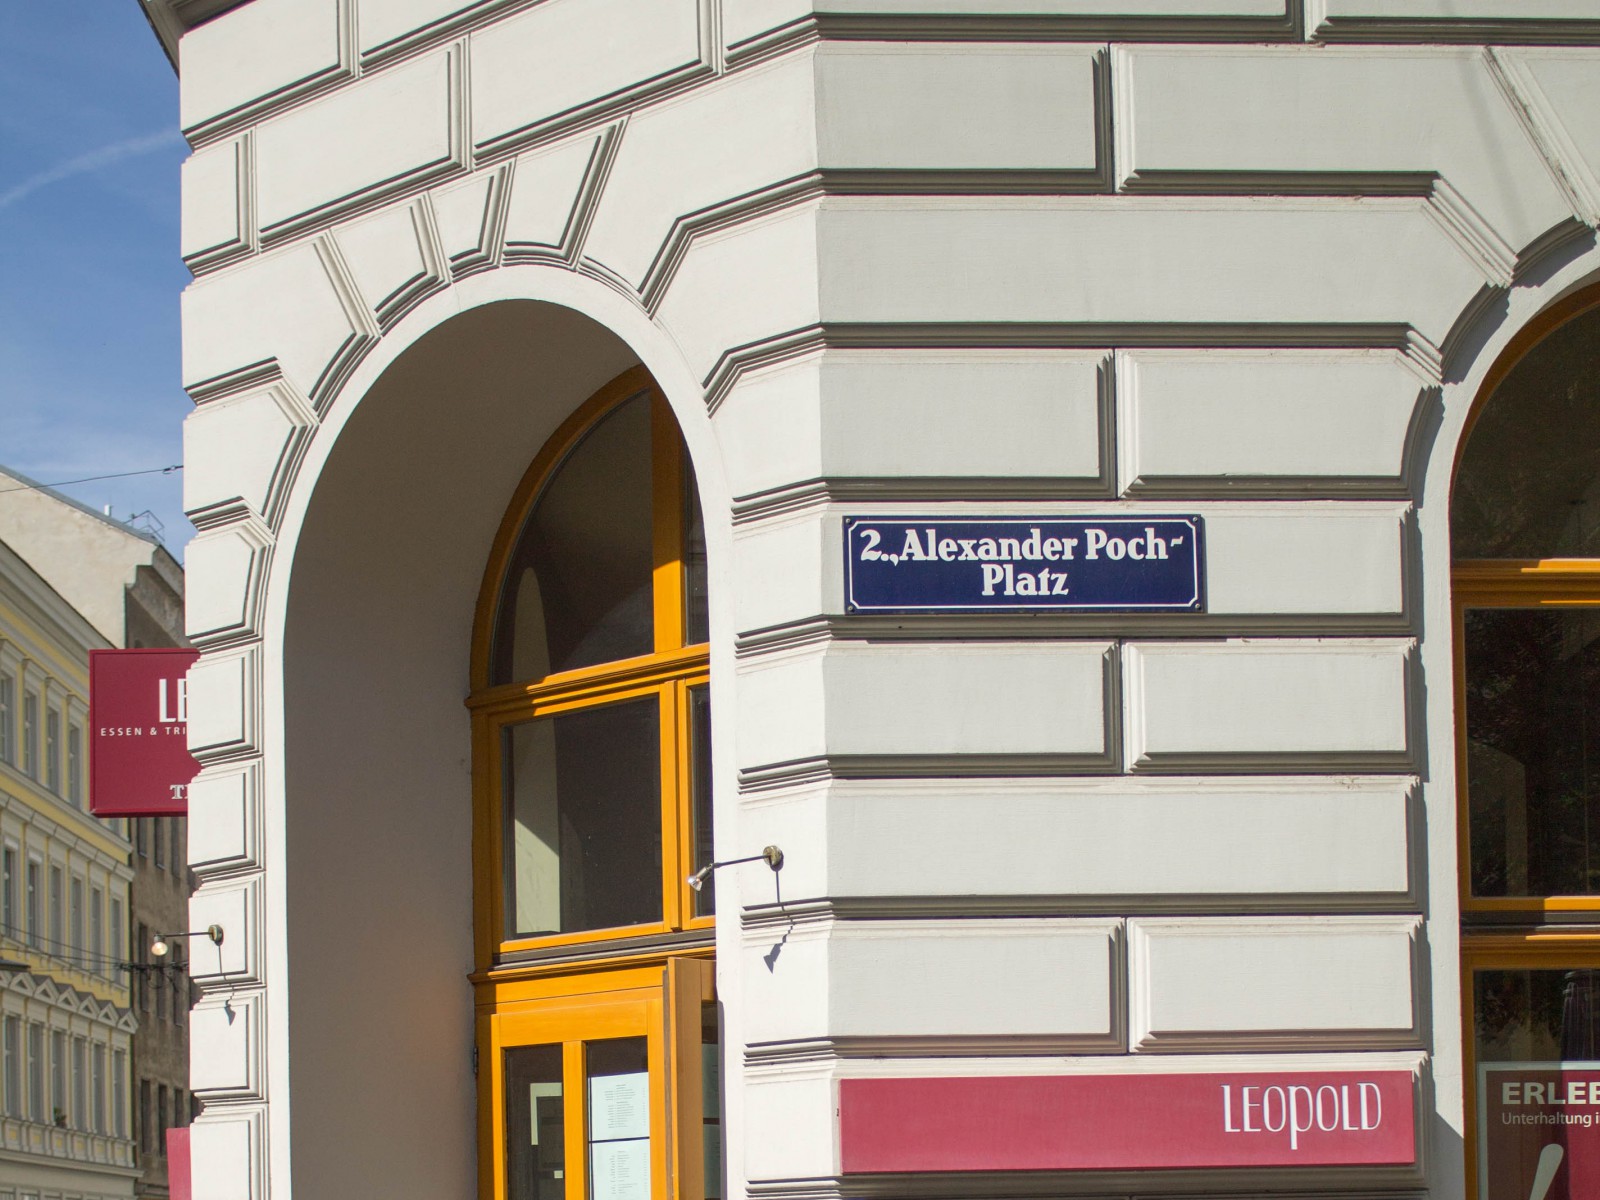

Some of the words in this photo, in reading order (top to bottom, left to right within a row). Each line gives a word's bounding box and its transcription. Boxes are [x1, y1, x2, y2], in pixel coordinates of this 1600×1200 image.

[981, 563, 1069, 596] Platz
[100, 727, 142, 736] ESSEN
[150, 727, 157, 736] &
[1502, 1111, 1592, 1128] Unterhaltung
